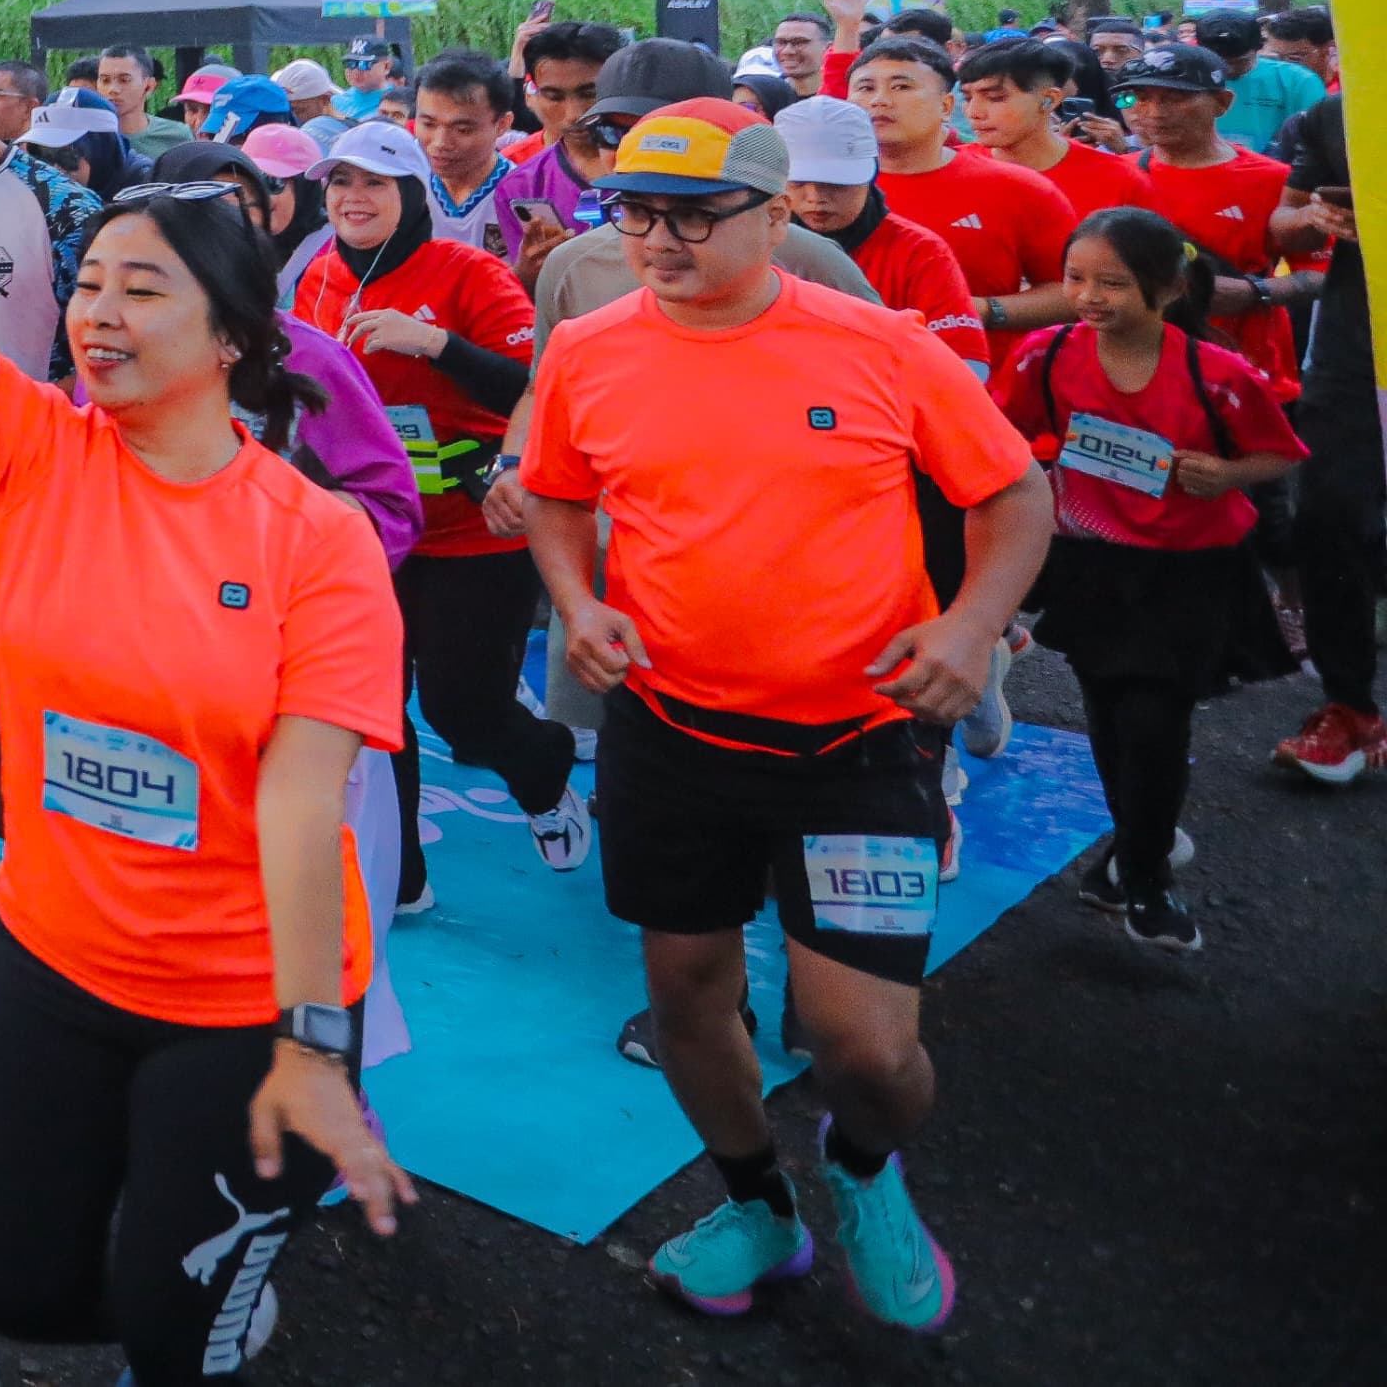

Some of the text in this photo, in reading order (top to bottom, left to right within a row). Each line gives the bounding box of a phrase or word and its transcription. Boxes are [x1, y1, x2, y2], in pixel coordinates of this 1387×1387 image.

[1079, 432, 1158, 472] 0124
[61, 749, 175, 805] 1804
[824, 867, 925, 898] 1803
